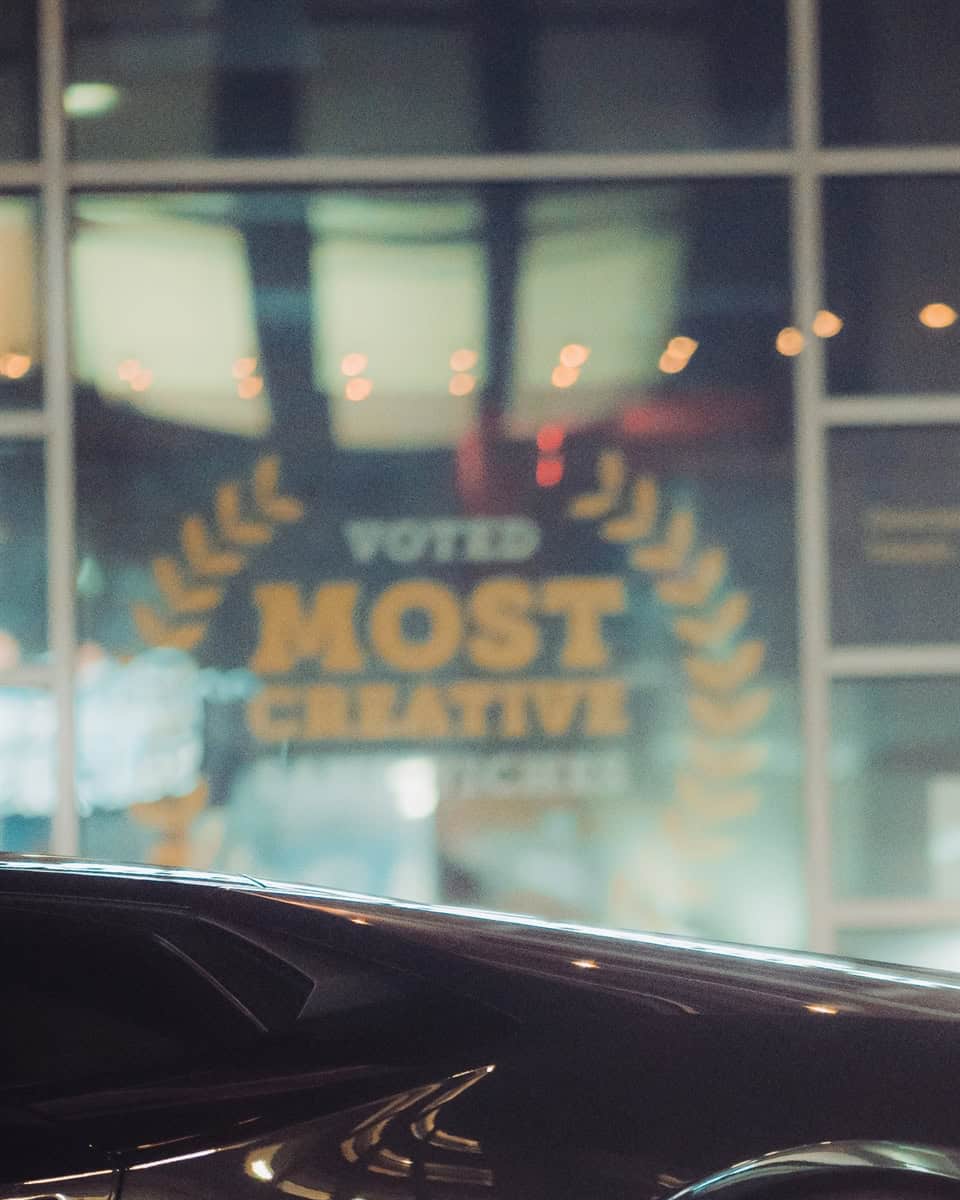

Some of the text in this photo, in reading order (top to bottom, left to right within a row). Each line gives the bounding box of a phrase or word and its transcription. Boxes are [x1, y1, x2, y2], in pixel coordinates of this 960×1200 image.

[345, 517, 541, 563] VOTED
[250, 577, 626, 673] MOST
[247, 680, 631, 743] CREATIVE
